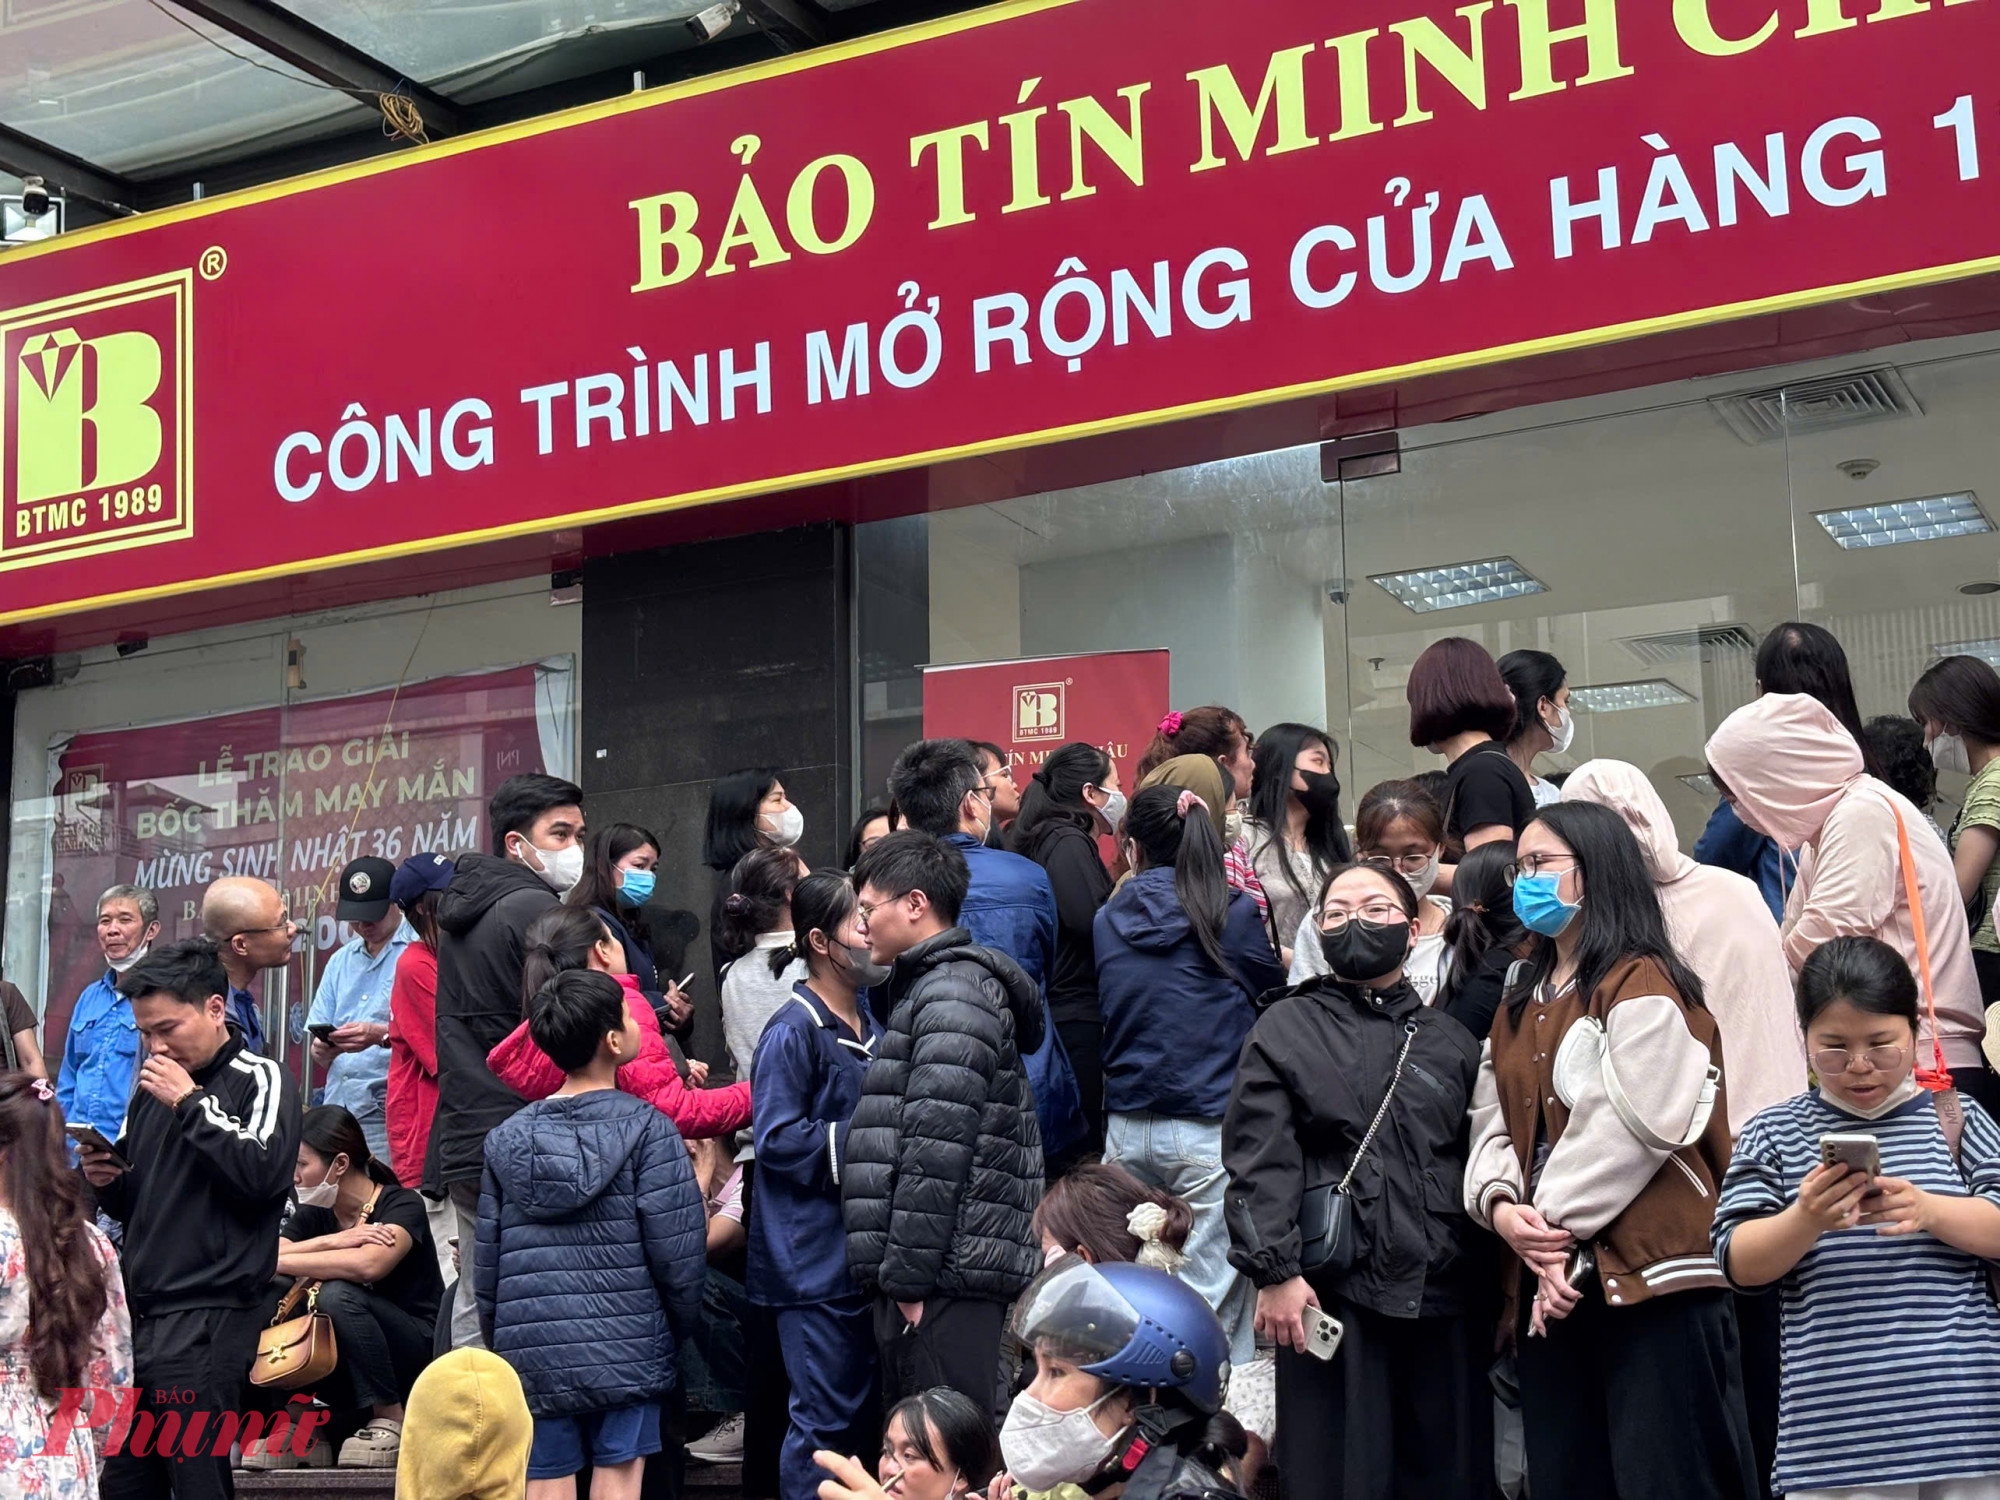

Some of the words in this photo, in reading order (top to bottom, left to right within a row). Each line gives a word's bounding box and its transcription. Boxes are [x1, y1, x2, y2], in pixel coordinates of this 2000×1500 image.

[629, 134, 874, 293] BẢO
[910, 77, 1151, 230] TÍN
[1186, 0, 1634, 172] MINH
[274, 398, 493, 502] CÔNG
[521, 341, 771, 455] TRÌNH
[806, 281, 942, 404] MỞ
[973, 247, 1251, 373] RỘNG
[1290, 177, 1514, 308] CỬA
[1550, 117, 1886, 259] HÀNG
[1934, 95, 1979, 180] 1
[17, 498, 87, 537] BTMC
[98, 484, 162, 522] 1989
[198, 744, 234, 788] LỄ
[243, 743, 332, 781] TRAO
[342, 723, 410, 767] GIẢI
[137, 797, 203, 840] BỐC
[210, 787, 303, 830] THĂM
[315, 778, 388, 816] MAY
[398, 758, 475, 804] MẮN
[133, 848, 213, 890] MỪNG
[219, 839, 284, 878] SINH
[291, 824, 367, 873] NHẬT
[371, 826, 403, 860] 36
[411, 811, 478, 856] NĂM
